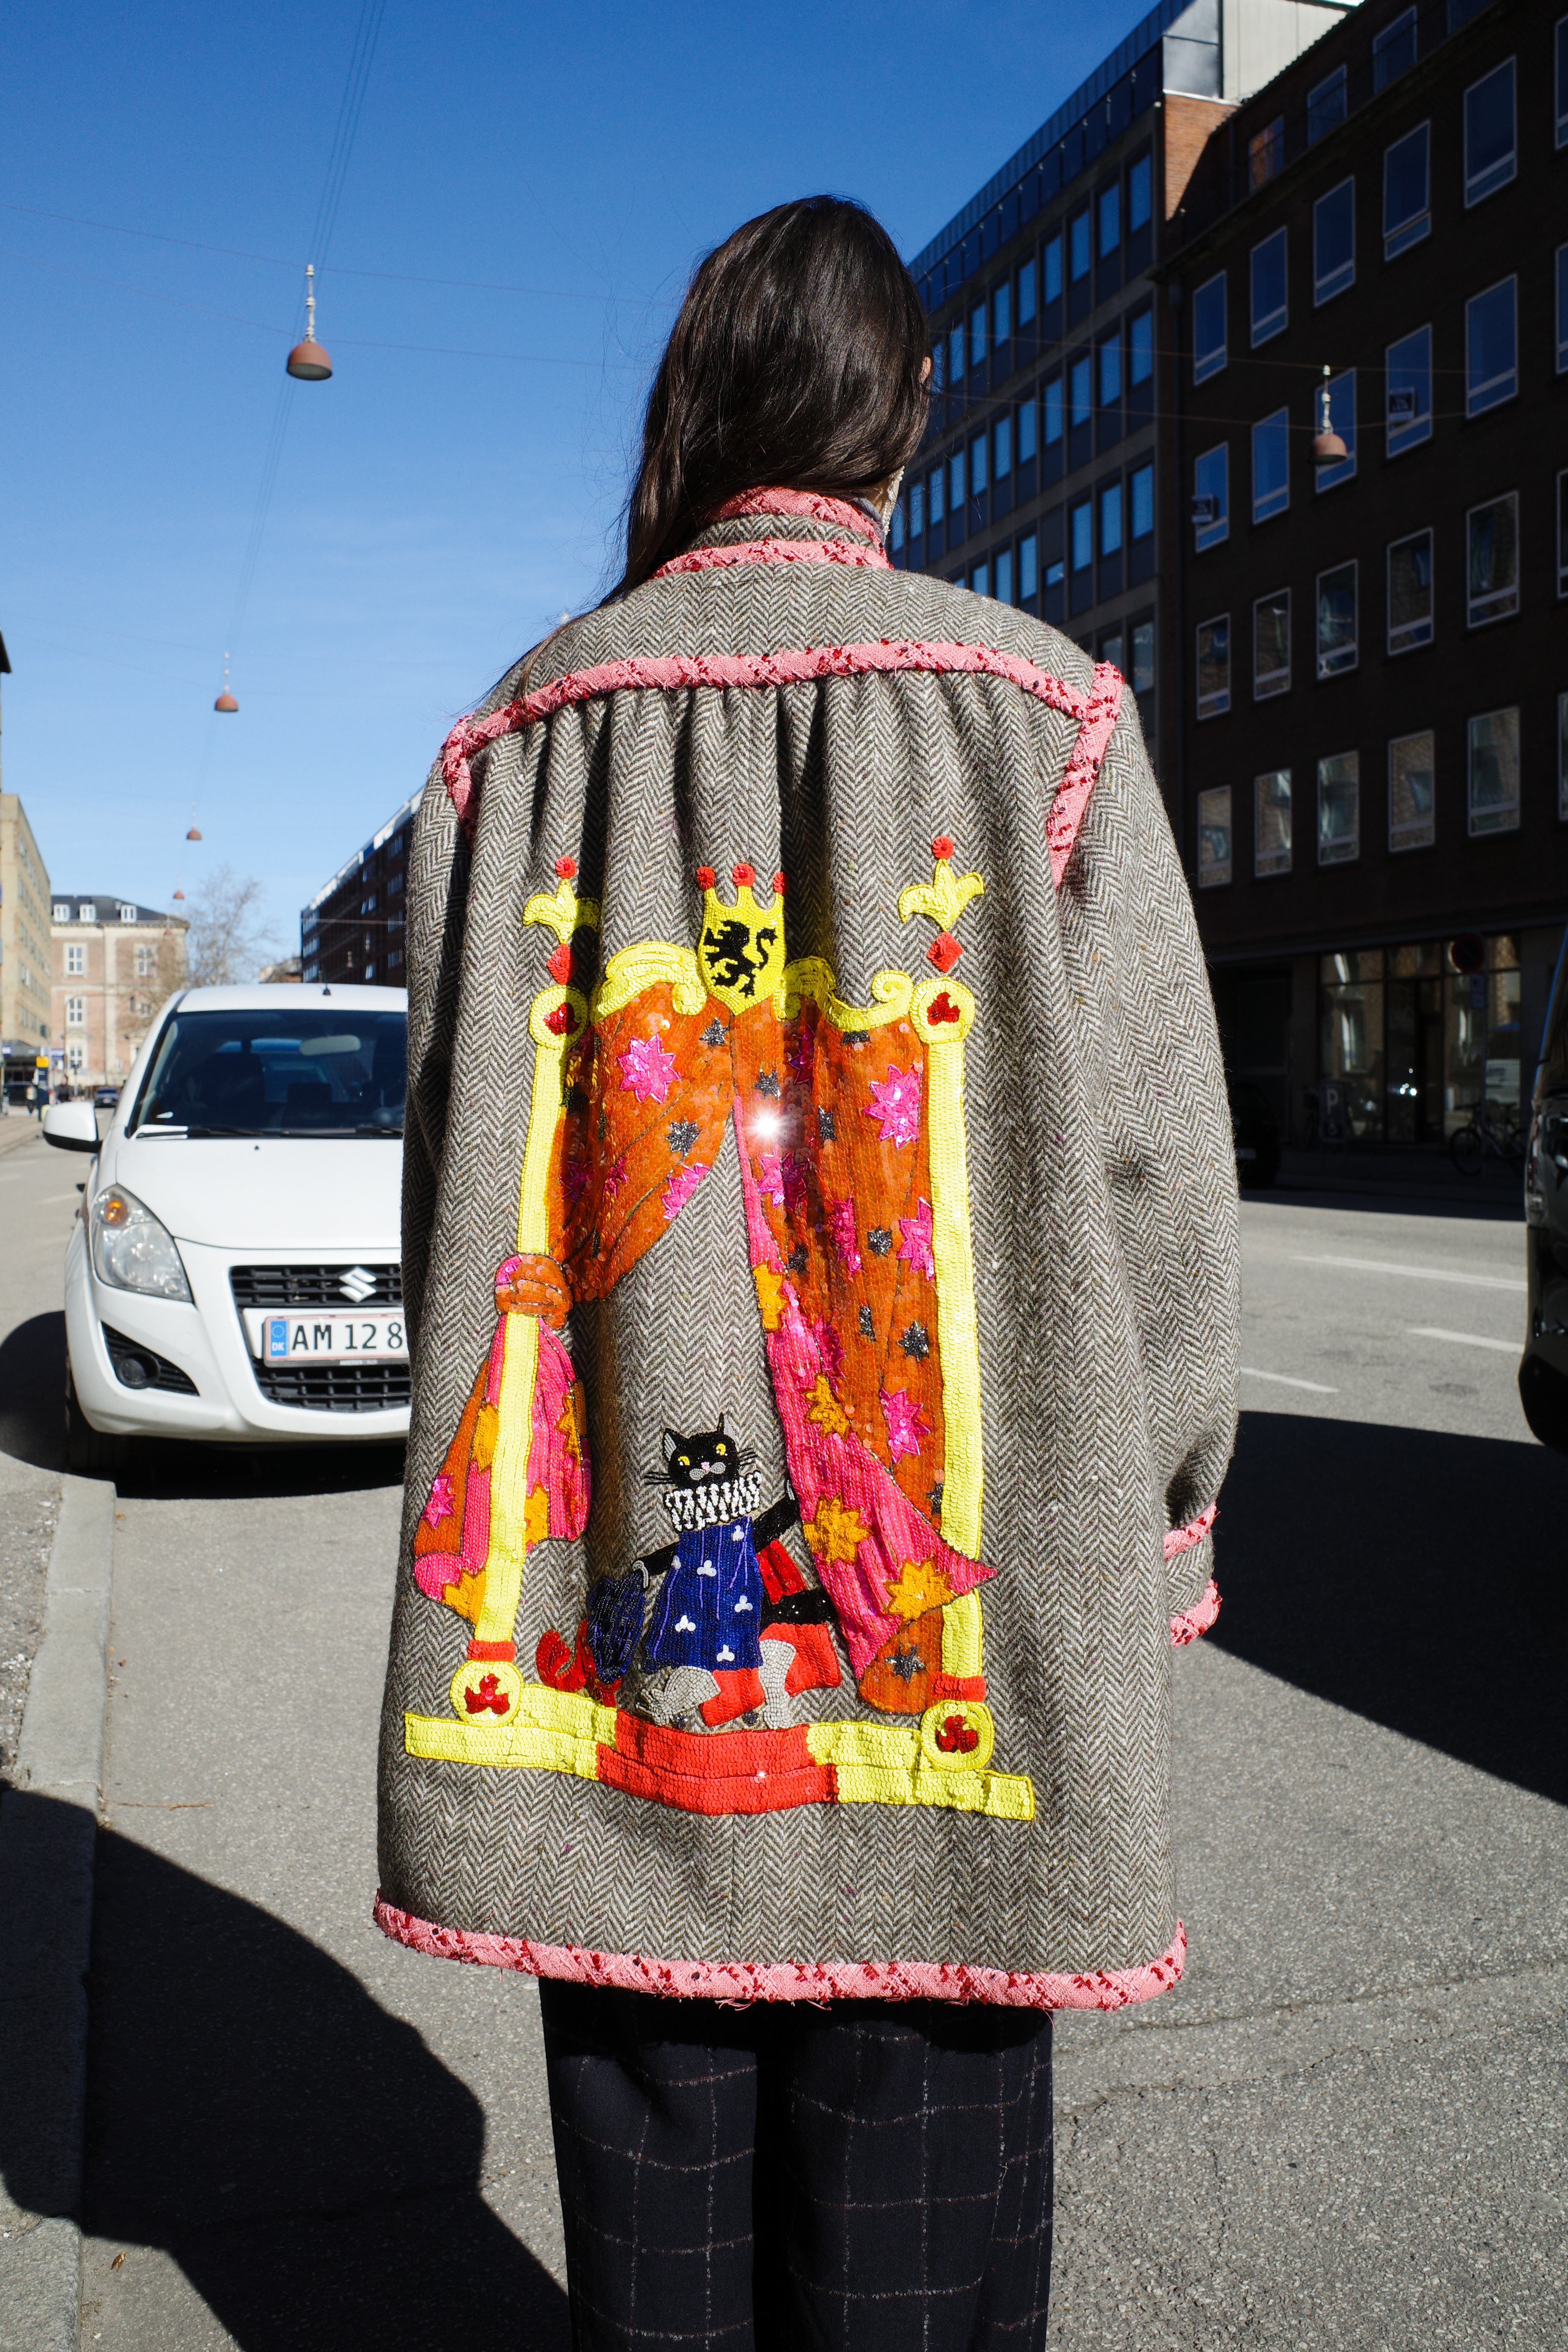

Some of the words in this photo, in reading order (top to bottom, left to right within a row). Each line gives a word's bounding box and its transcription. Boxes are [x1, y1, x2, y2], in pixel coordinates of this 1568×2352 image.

[1326, 1088, 1339, 1114] P
[272, 1341, 285, 1352] DK
[292, 1324, 332, 1350] AM
[345, 1324, 377, 1349] 12
